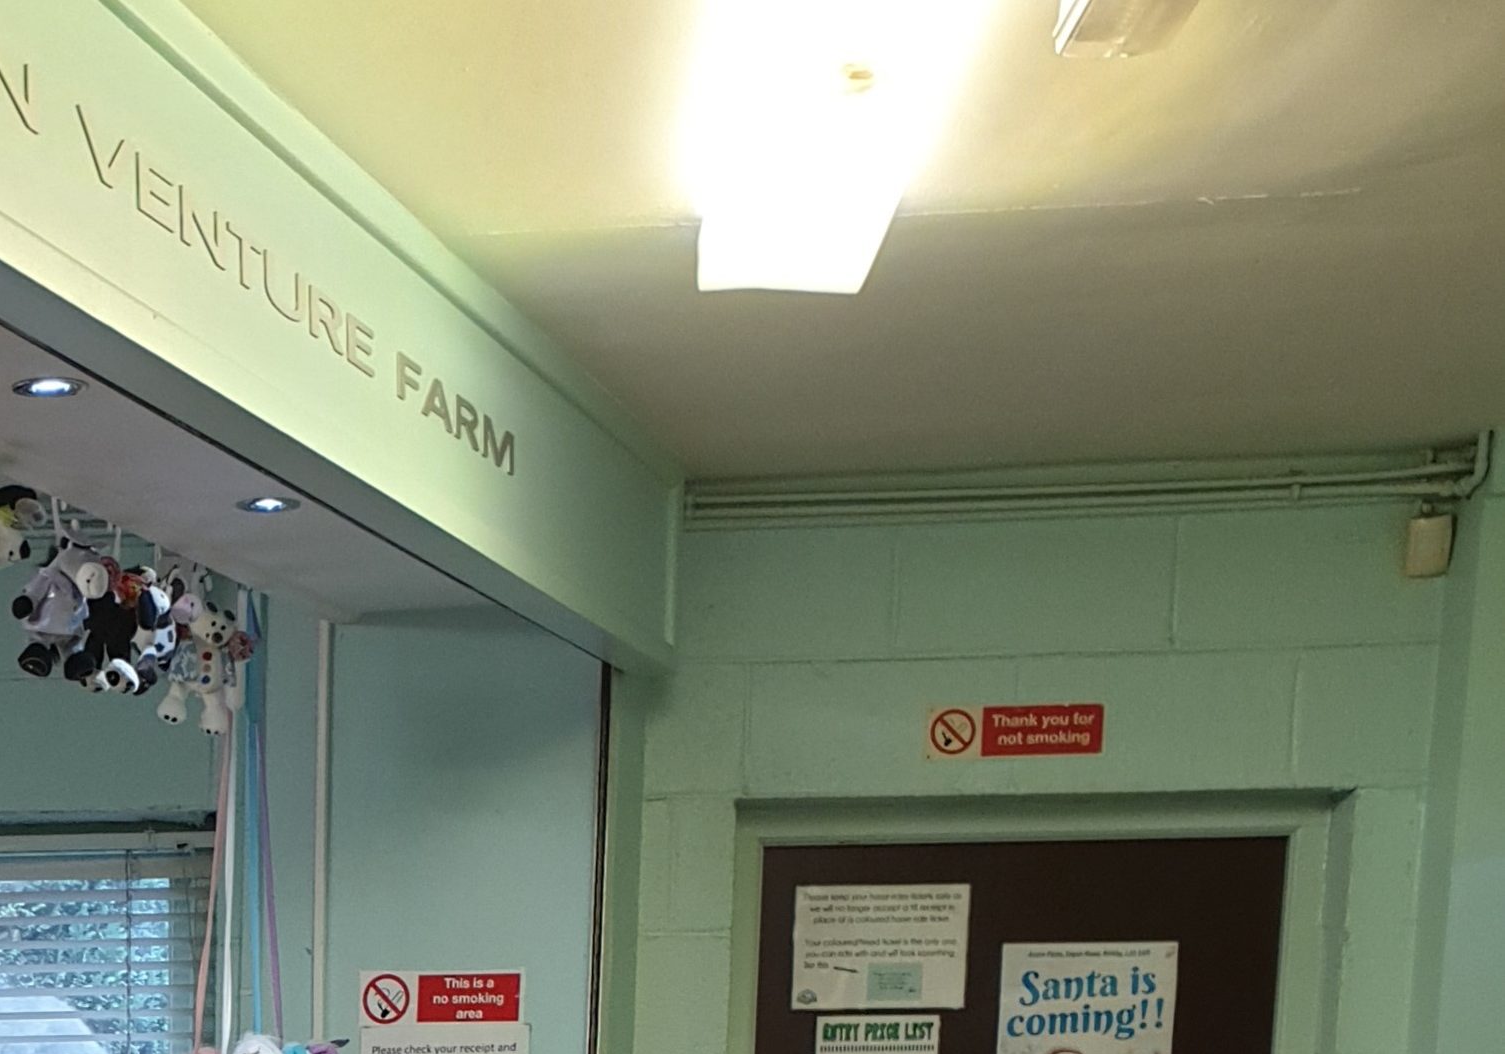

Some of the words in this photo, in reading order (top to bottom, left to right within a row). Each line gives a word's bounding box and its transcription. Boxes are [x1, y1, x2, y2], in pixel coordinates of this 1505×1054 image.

[74, 103, 376, 378] VENTURE
[396, 350, 517, 476] FARM
[992, 713, 1038, 728] Thank
[1041, 715, 1070, 730] you
[1072, 711, 1095, 726] for
[997, 732, 1023, 746] not
[1026, 730, 1092, 747] smoking
[444, 977, 471, 989] This
[472, 977, 485, 989] is
[485, 979, 495, 989] a
[1018, 968, 1119, 1007] Santa
[1130, 965, 1157, 996] is
[432, 994, 449, 1004] no
[451, 992, 504, 1006] smoking
[455, 1009, 483, 1020] area
[1005, 997, 1166, 1040] coming!!
[822, 1021, 861, 1042] ENTRY
[864, 1021, 900, 1042] PRICE
[903, 1021, 934, 1042] LIST
[404, 1043, 432, 1054] check
[496, 1042, 517, 1053] and
